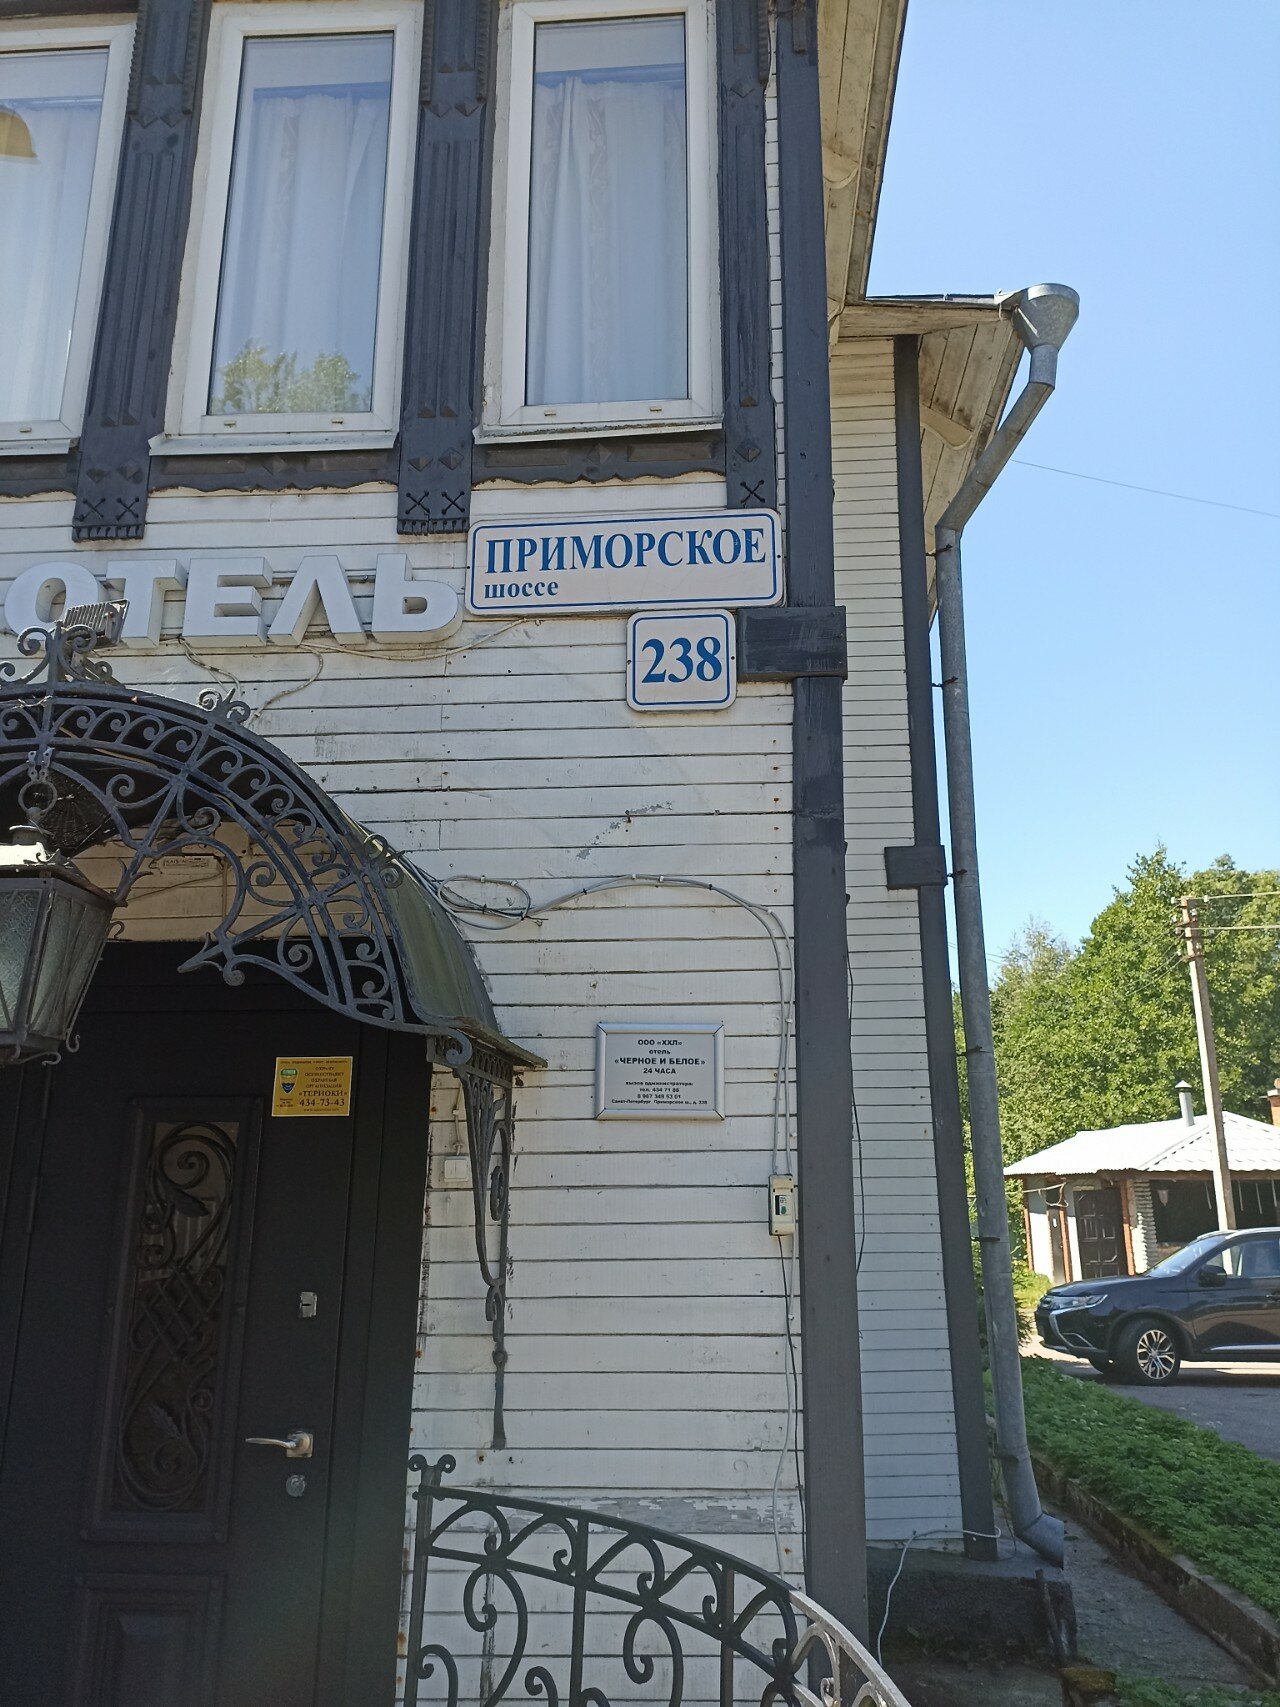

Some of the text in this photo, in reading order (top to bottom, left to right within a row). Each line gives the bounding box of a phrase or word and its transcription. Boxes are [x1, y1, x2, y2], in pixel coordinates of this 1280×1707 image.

[484, 527, 767, 574] ПРИМОРСКОЕ
[4, 552, 462, 648] ОТЕЛЬ
[484, 581, 559, 599] шоссе
[641, 636, 722, 684] 238
[614, 1057, 657, 1065] «ЧЕРНОЕ
[668, 1058, 706, 1066] БЕЛОЕ»
[299, 1098, 345, 1107] 434-73-43
